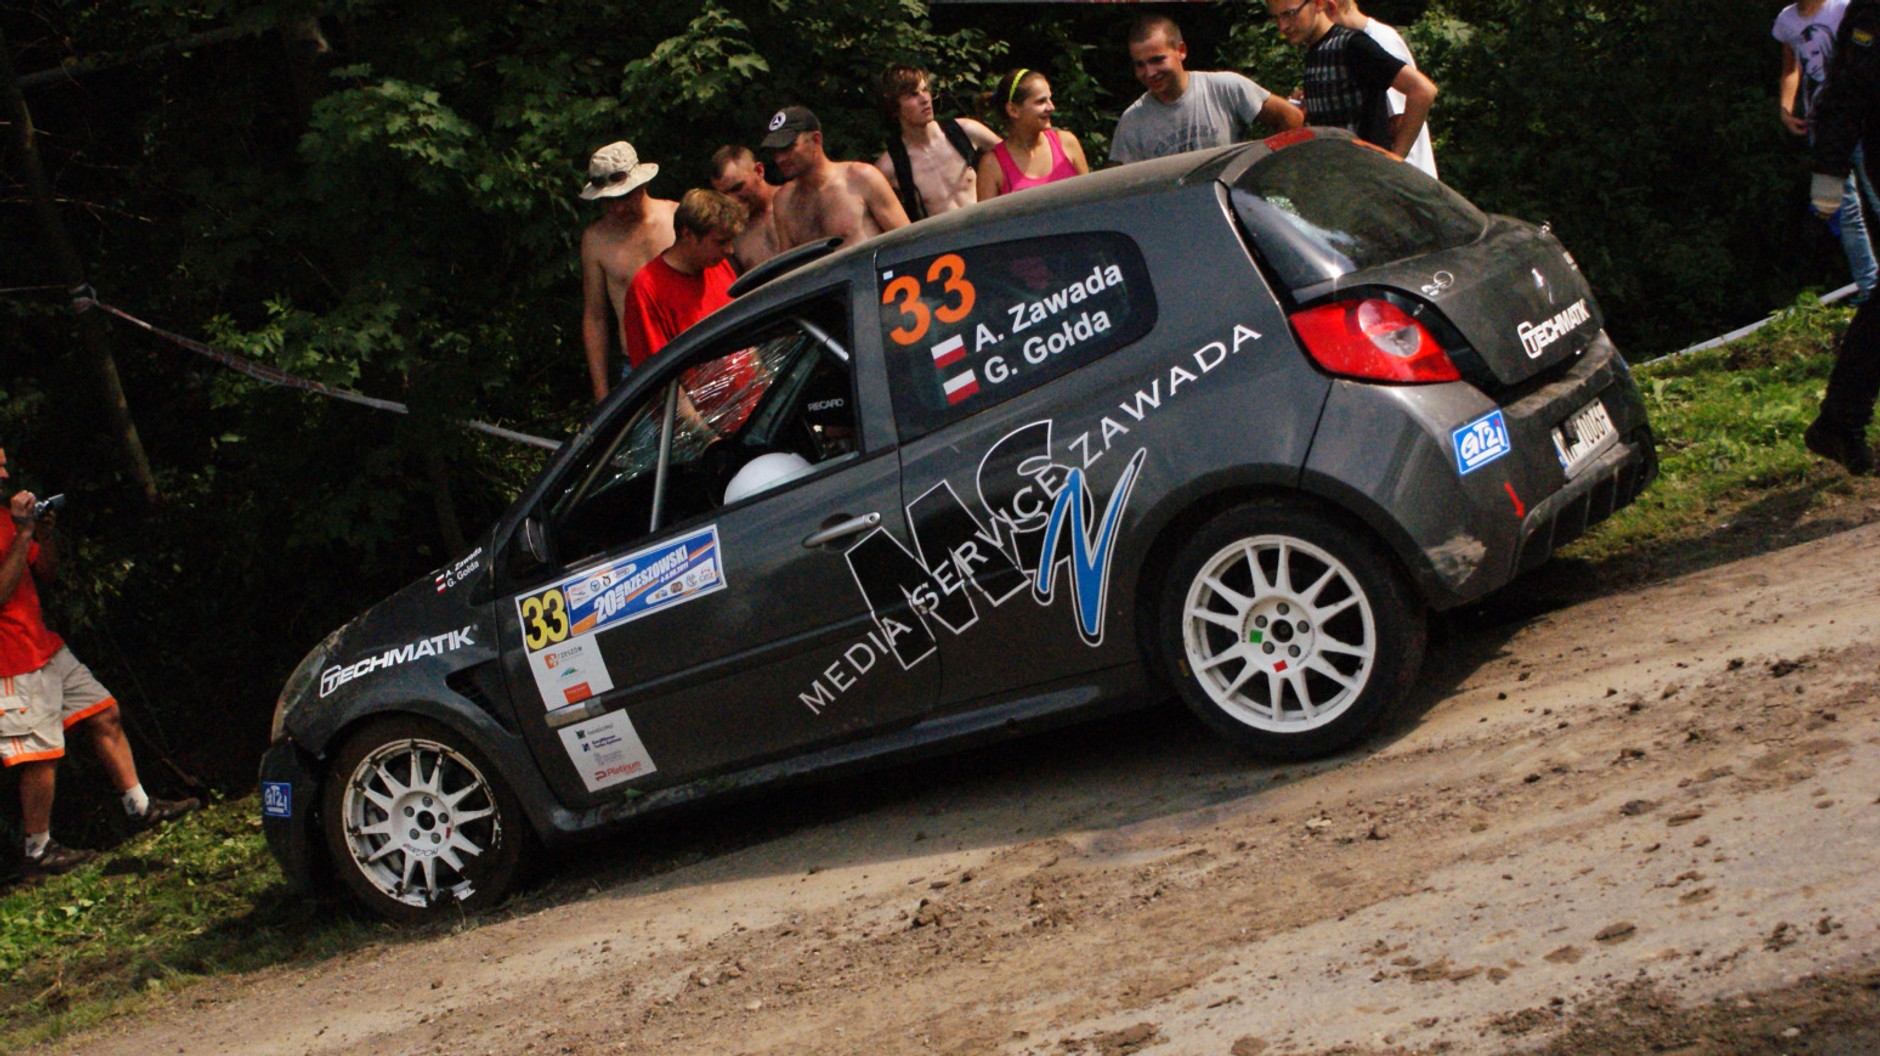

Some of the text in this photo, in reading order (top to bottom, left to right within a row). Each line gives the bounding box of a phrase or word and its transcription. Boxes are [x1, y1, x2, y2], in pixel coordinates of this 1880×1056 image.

[882, 253, 976, 346] 33
[974, 264, 1124, 353] A. Zawada
[1517, 298, 1590, 359] TECHMATIK
[984, 309, 1111, 385] G. Gołda
[808, 399, 844, 412] RECARO
[797, 323, 1263, 716] MEDIA SERVICE ZAWADA
[446, 578, 456, 588] G.
[521, 589, 569, 650] 33
[594, 591, 617, 624] 20
[624, 544, 689, 596] RZESZOWSKI
[320, 625, 475, 699] TECHMATIK
